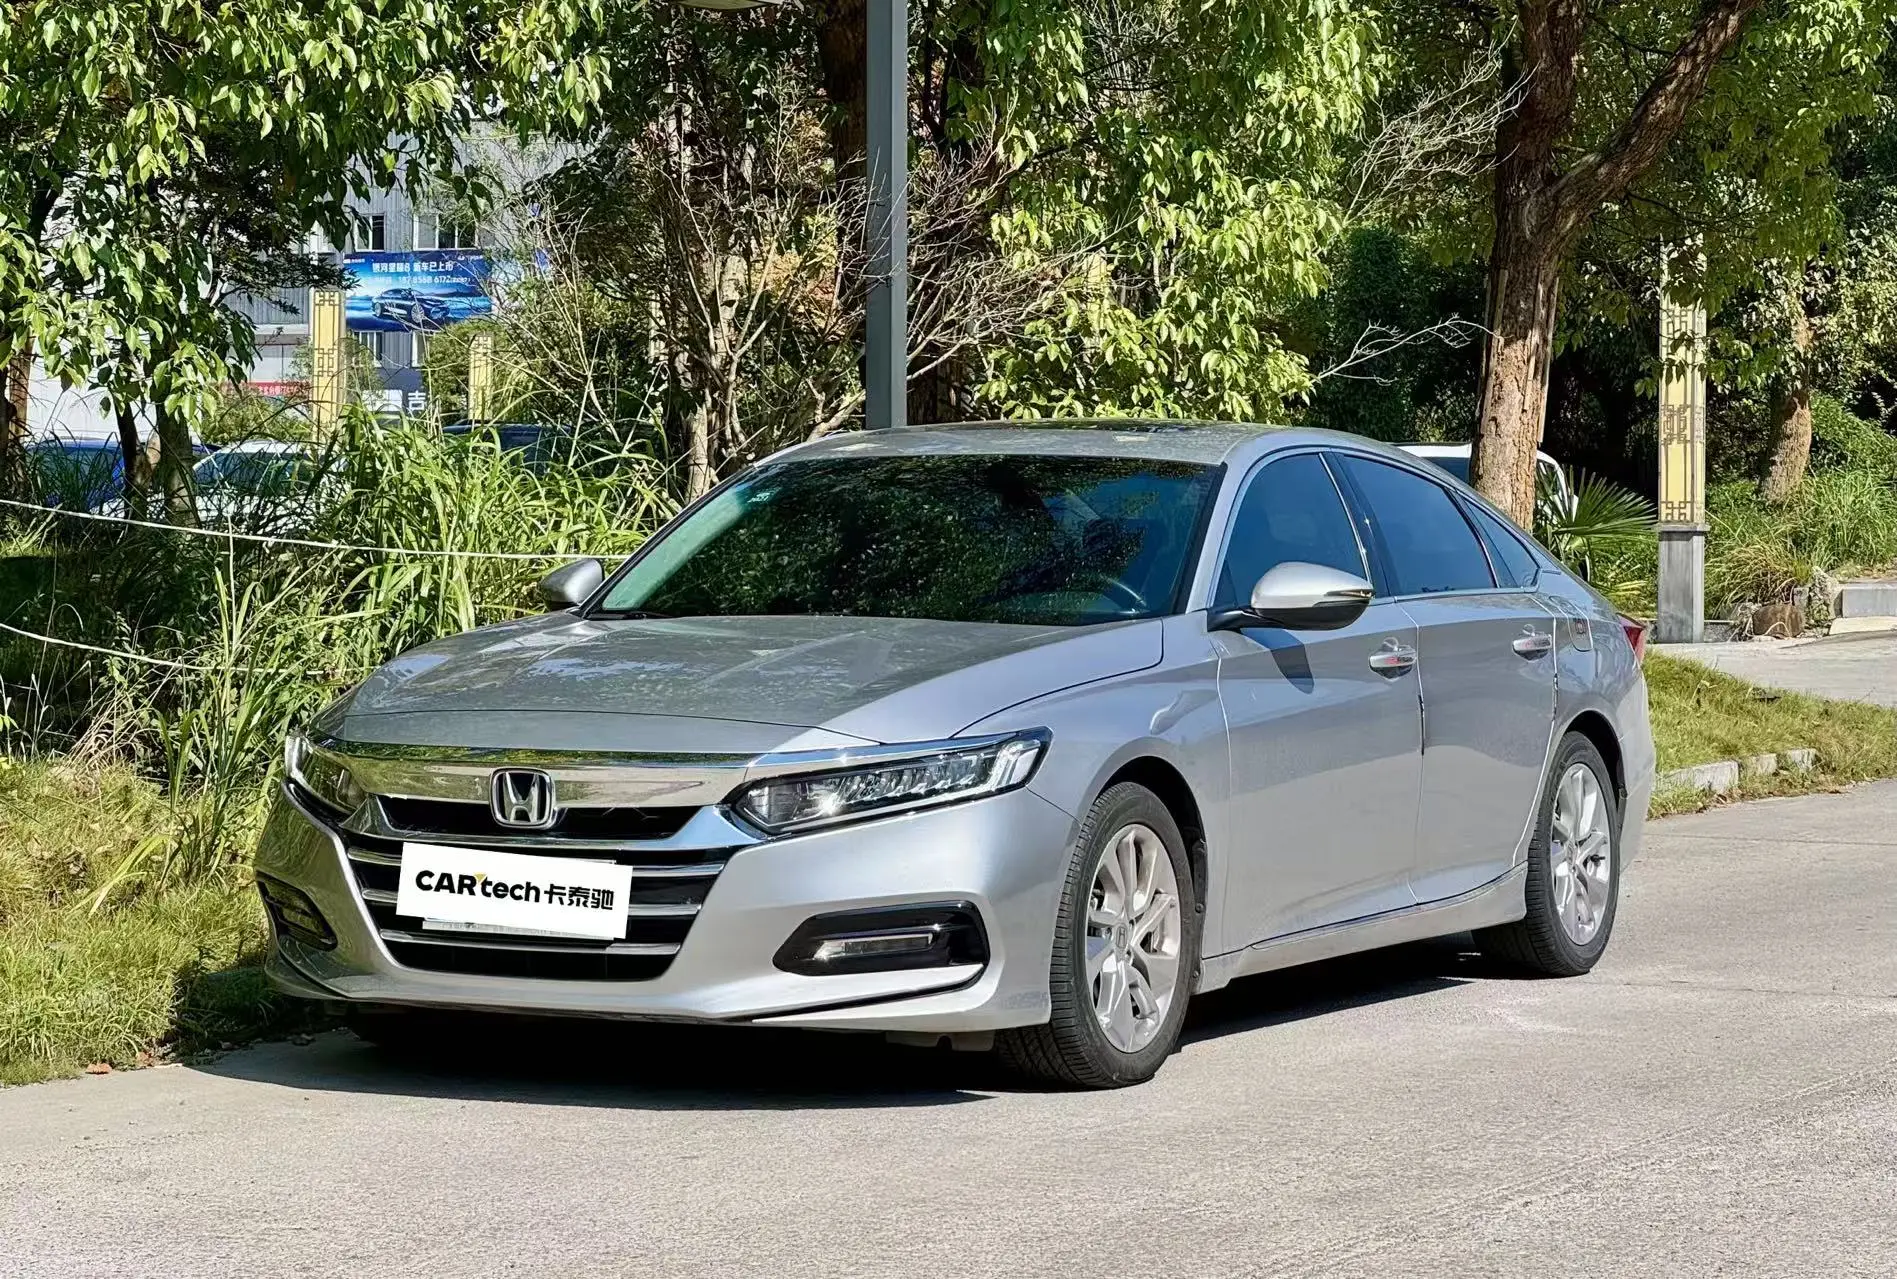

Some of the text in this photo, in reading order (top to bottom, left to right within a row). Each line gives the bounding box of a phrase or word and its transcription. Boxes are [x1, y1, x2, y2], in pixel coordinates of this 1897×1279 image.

[413, 260, 454, 273] 新车已上市
[433, 275, 451, 284] 6172
[408, 390, 426, 411] 吉
